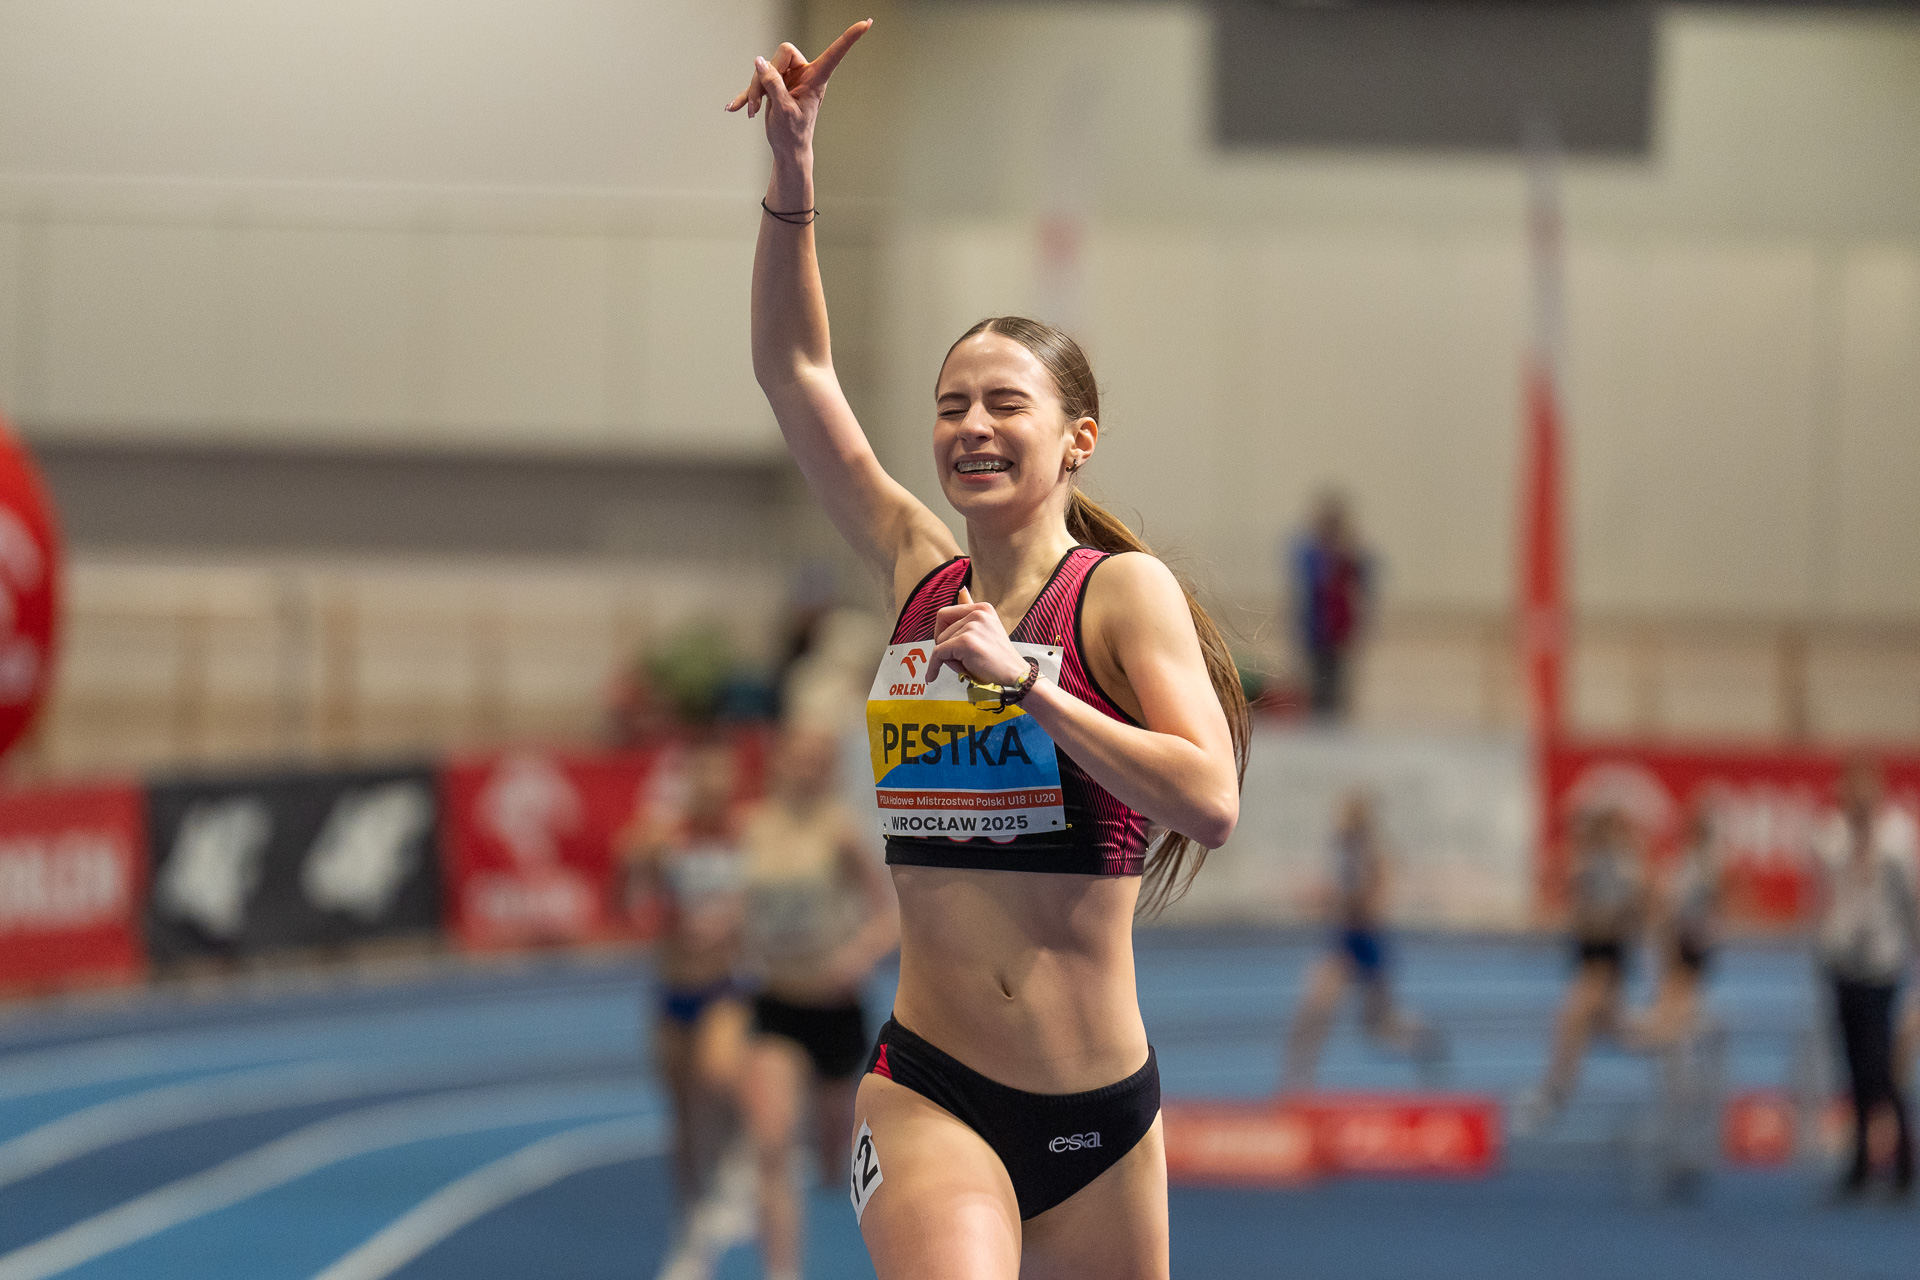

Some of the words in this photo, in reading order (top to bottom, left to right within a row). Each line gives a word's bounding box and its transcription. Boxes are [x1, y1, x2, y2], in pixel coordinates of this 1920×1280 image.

[889, 683, 925, 696] ORLEN
[882, 722, 1032, 766] PESTKA
[890, 796, 914, 805] Halowe
[916, 795, 974, 806] Mistrzostwa
[976, 796, 1005, 807] Polski
[1008, 795, 1026, 805] U18
[1034, 793, 1056, 803] U20
[891, 816, 977, 831] WROCŁAW
[981, 815, 1028, 831] 2025
[1048, 1131, 1103, 1153] esa
